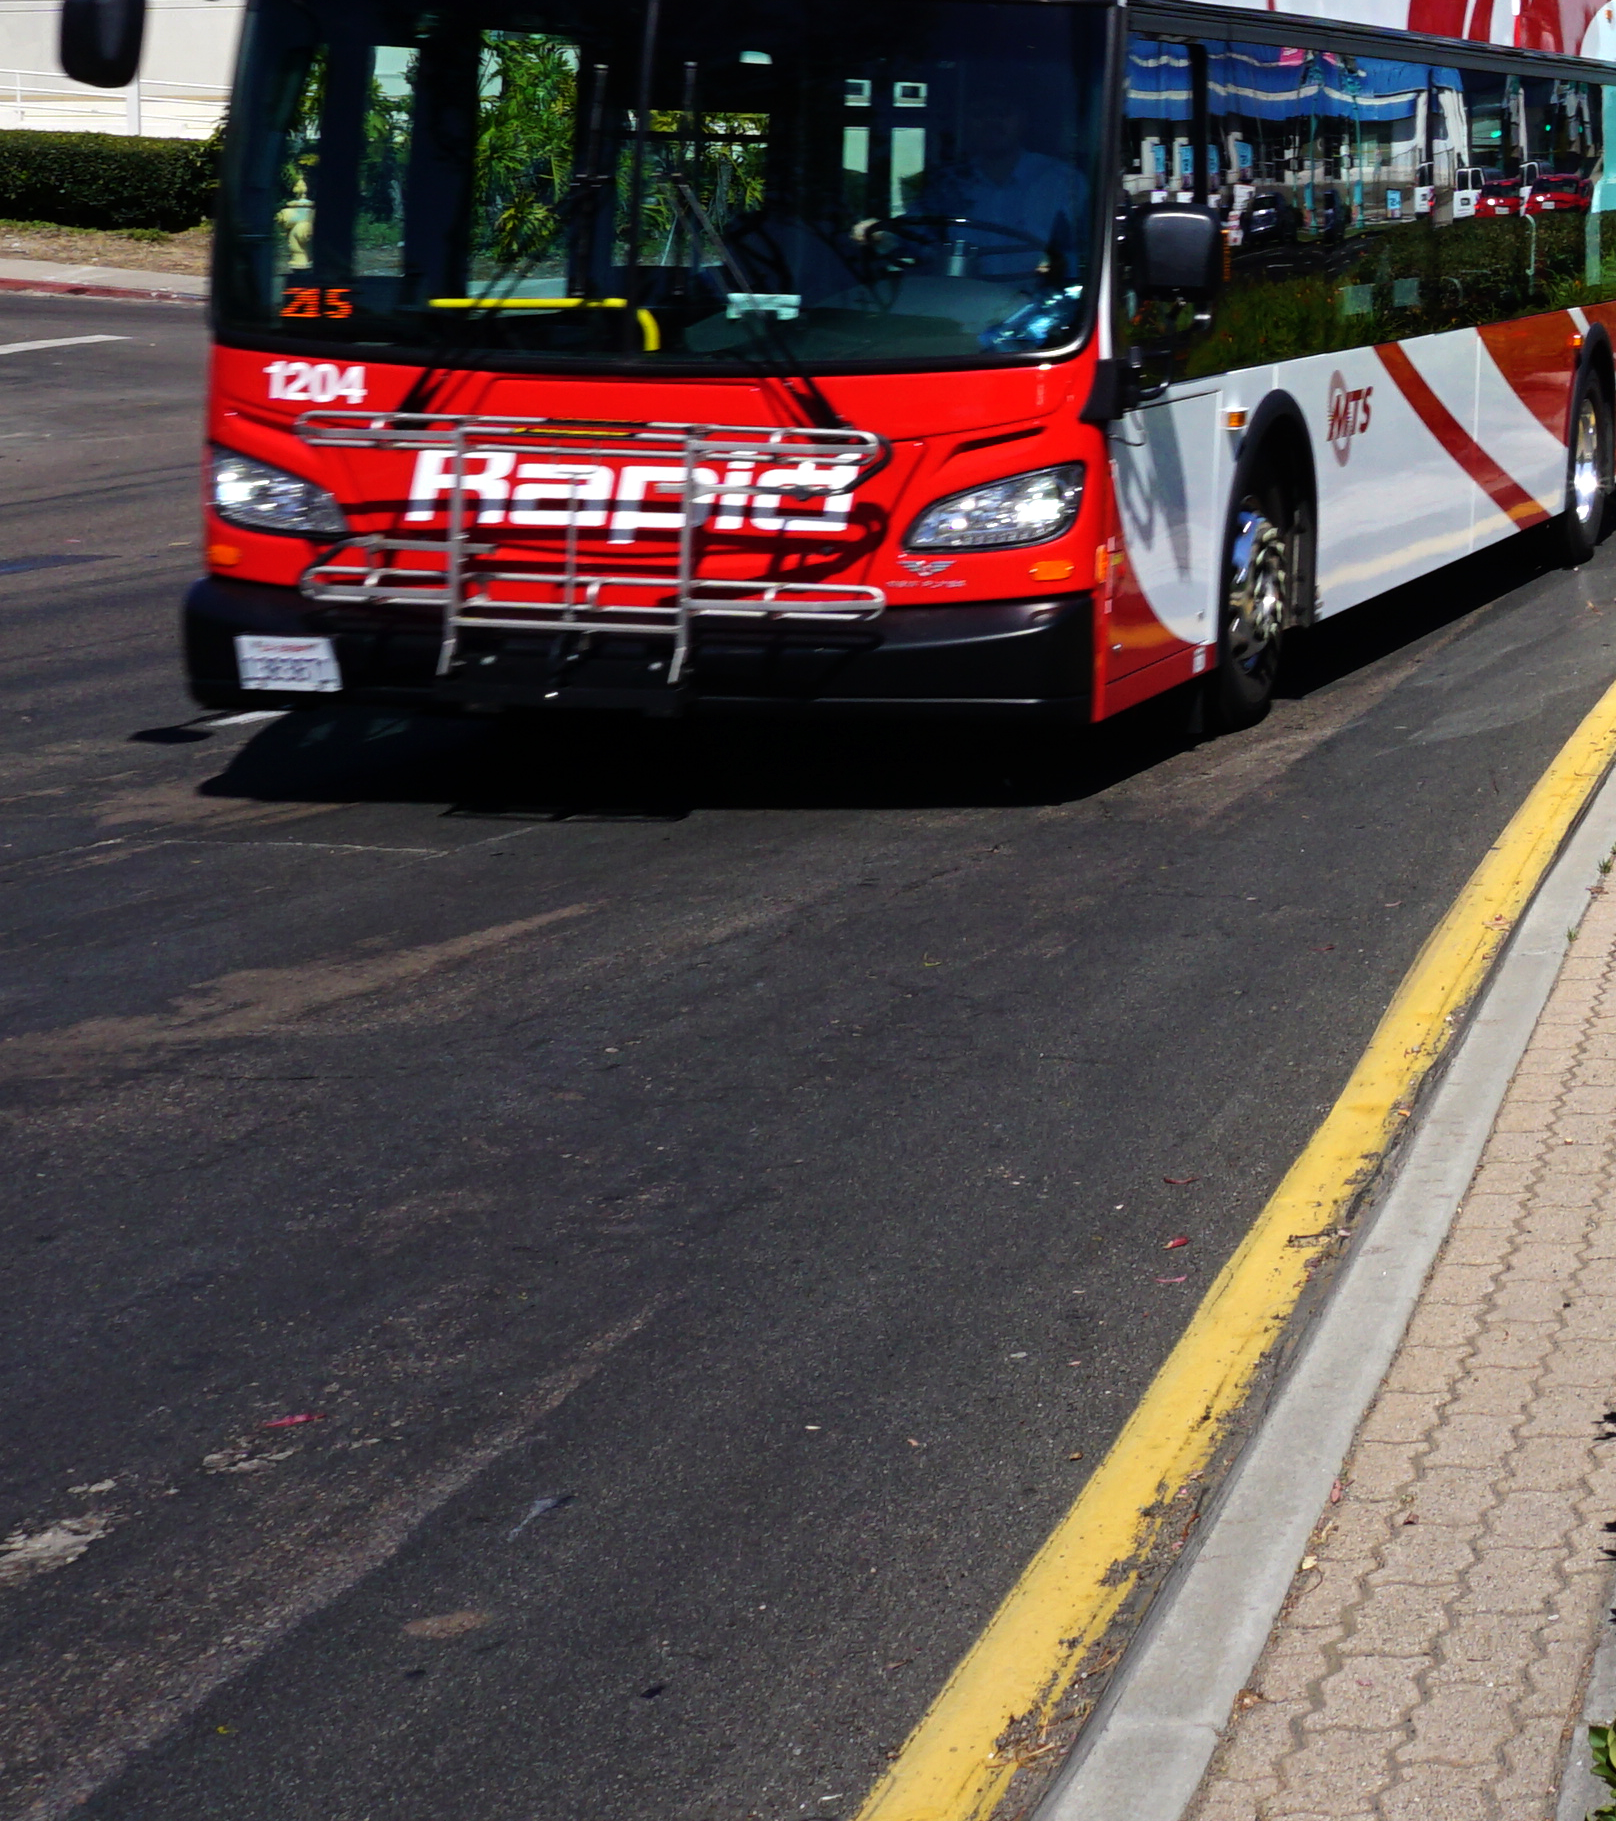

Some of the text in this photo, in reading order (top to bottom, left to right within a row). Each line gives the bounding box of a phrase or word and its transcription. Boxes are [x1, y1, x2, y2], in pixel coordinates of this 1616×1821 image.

[280, 287, 353, 318] 215
[262, 361, 368, 404] 1204
[1326, 386, 1373, 441] MTS
[405, 449, 861, 545] Rapid
